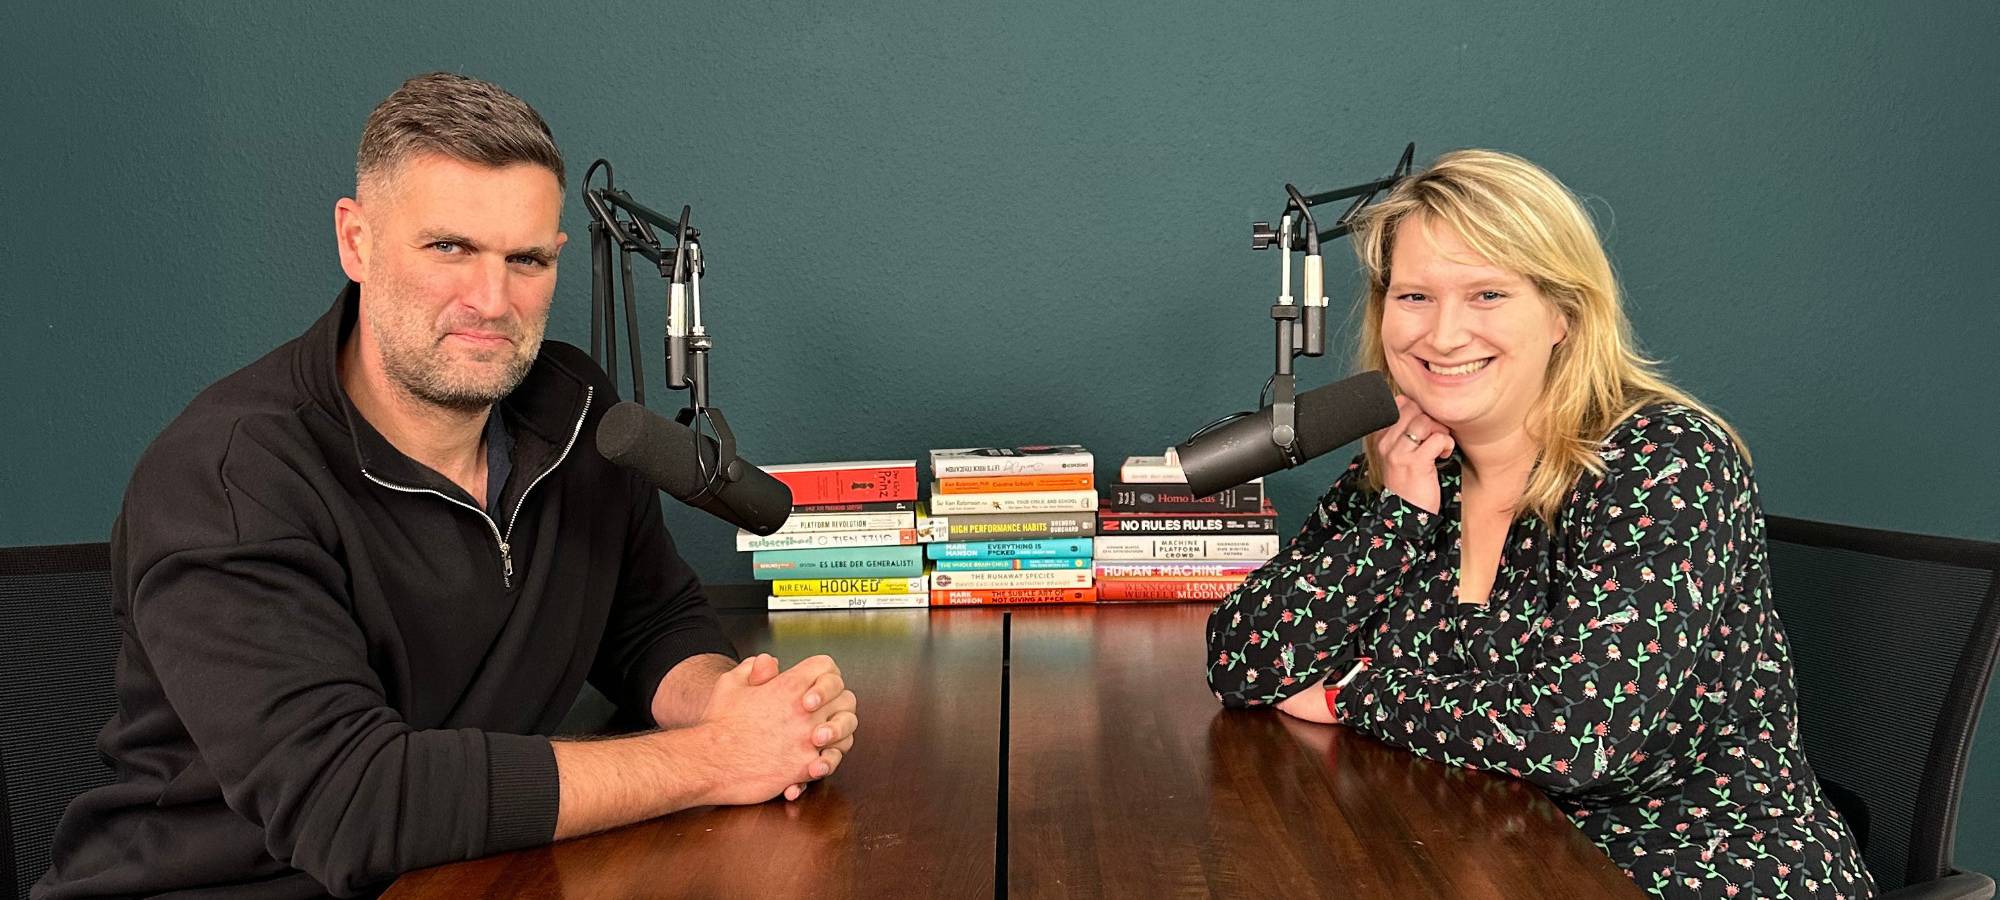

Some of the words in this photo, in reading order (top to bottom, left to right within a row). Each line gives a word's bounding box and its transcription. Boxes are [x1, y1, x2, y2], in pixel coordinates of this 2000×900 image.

[878, 471, 892, 498] Prinz
[1158, 494, 1189, 503] Homo
[800, 521, 830, 529] PLATFORM
[831, 520, 867, 528] REVOLUTION
[950, 525, 966, 534] HIGH
[969, 523, 1021, 533] PERFORMANCE
[1022, 523, 1047, 532] HABITS
[1121, 520, 1139, 530] NO
[1141, 520, 1179, 530] RULES
[1180, 519, 1223, 530] RULES
[819, 561, 829, 569] ES
[830, 561, 847, 569] LEBE
[850, 560, 864, 568] DER
[866, 560, 914, 568] GENERALIST!
[820, 579, 881, 593] HOOKED
[848, 597, 867, 607] play
